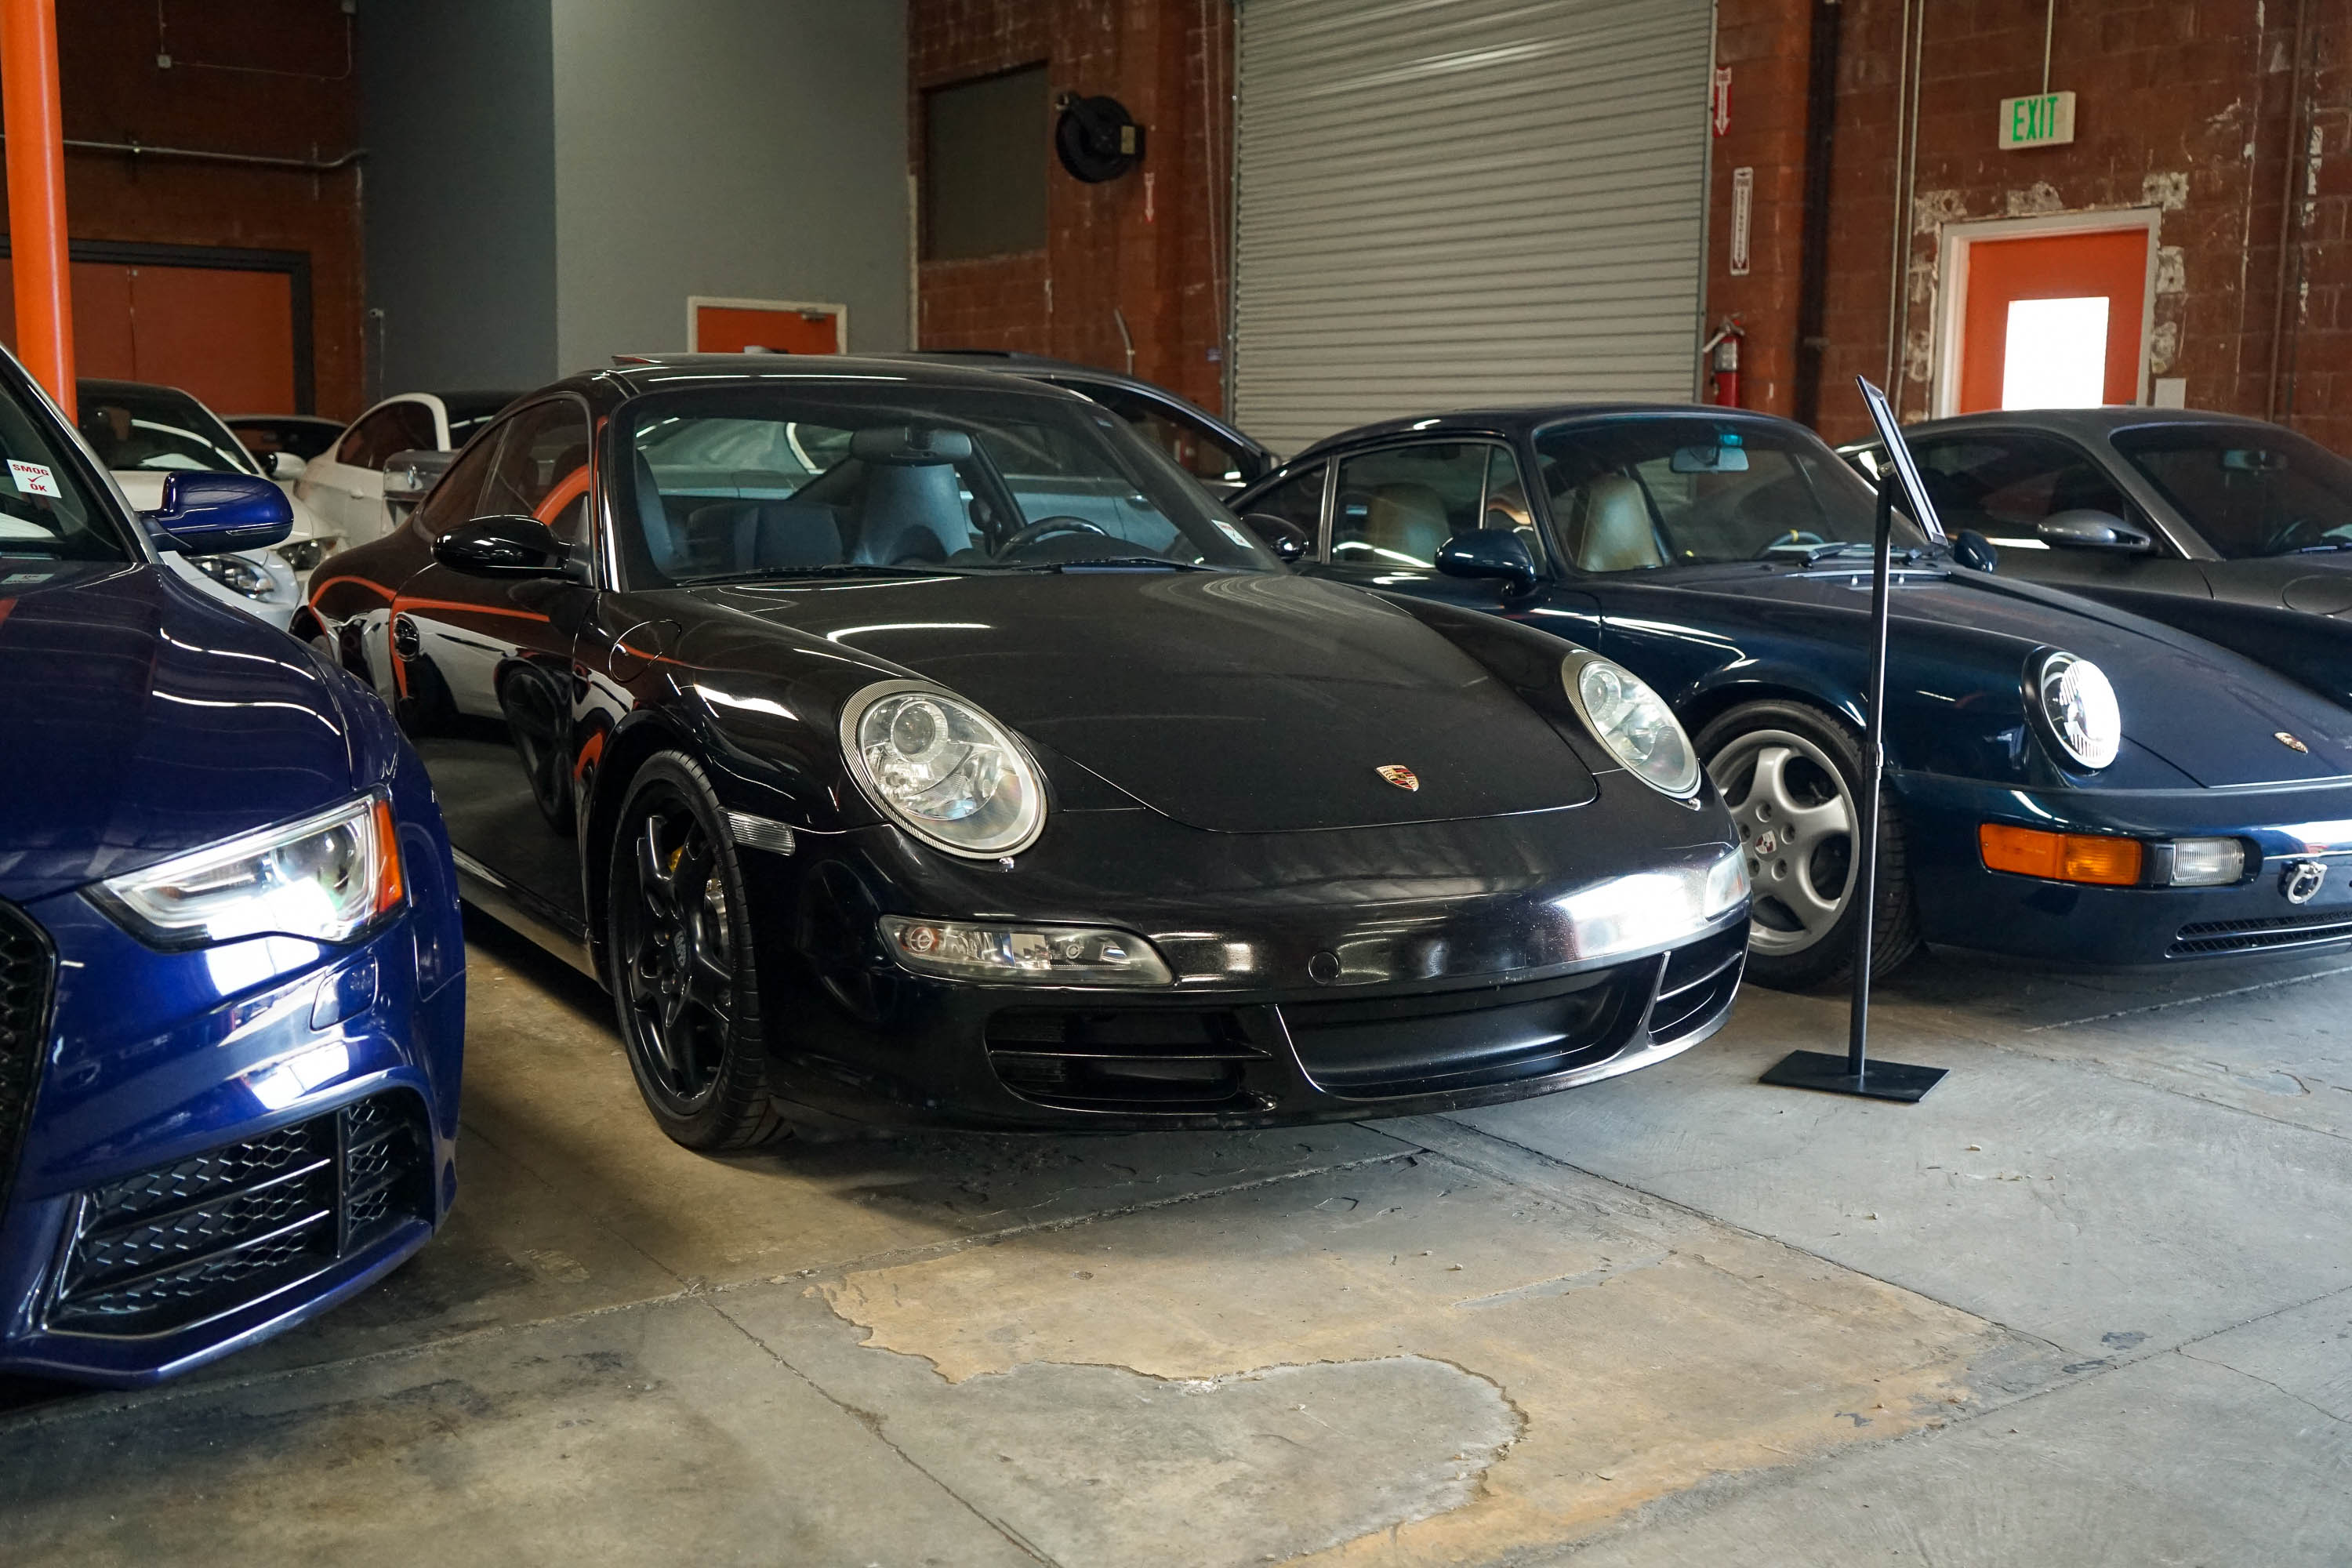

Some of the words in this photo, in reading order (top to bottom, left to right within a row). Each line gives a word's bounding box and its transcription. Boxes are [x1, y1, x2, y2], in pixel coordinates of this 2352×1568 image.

[2013, 96, 2058, 141] EXIT
[12, 463, 49, 476] SMOG
[30, 483, 47, 492] OK
